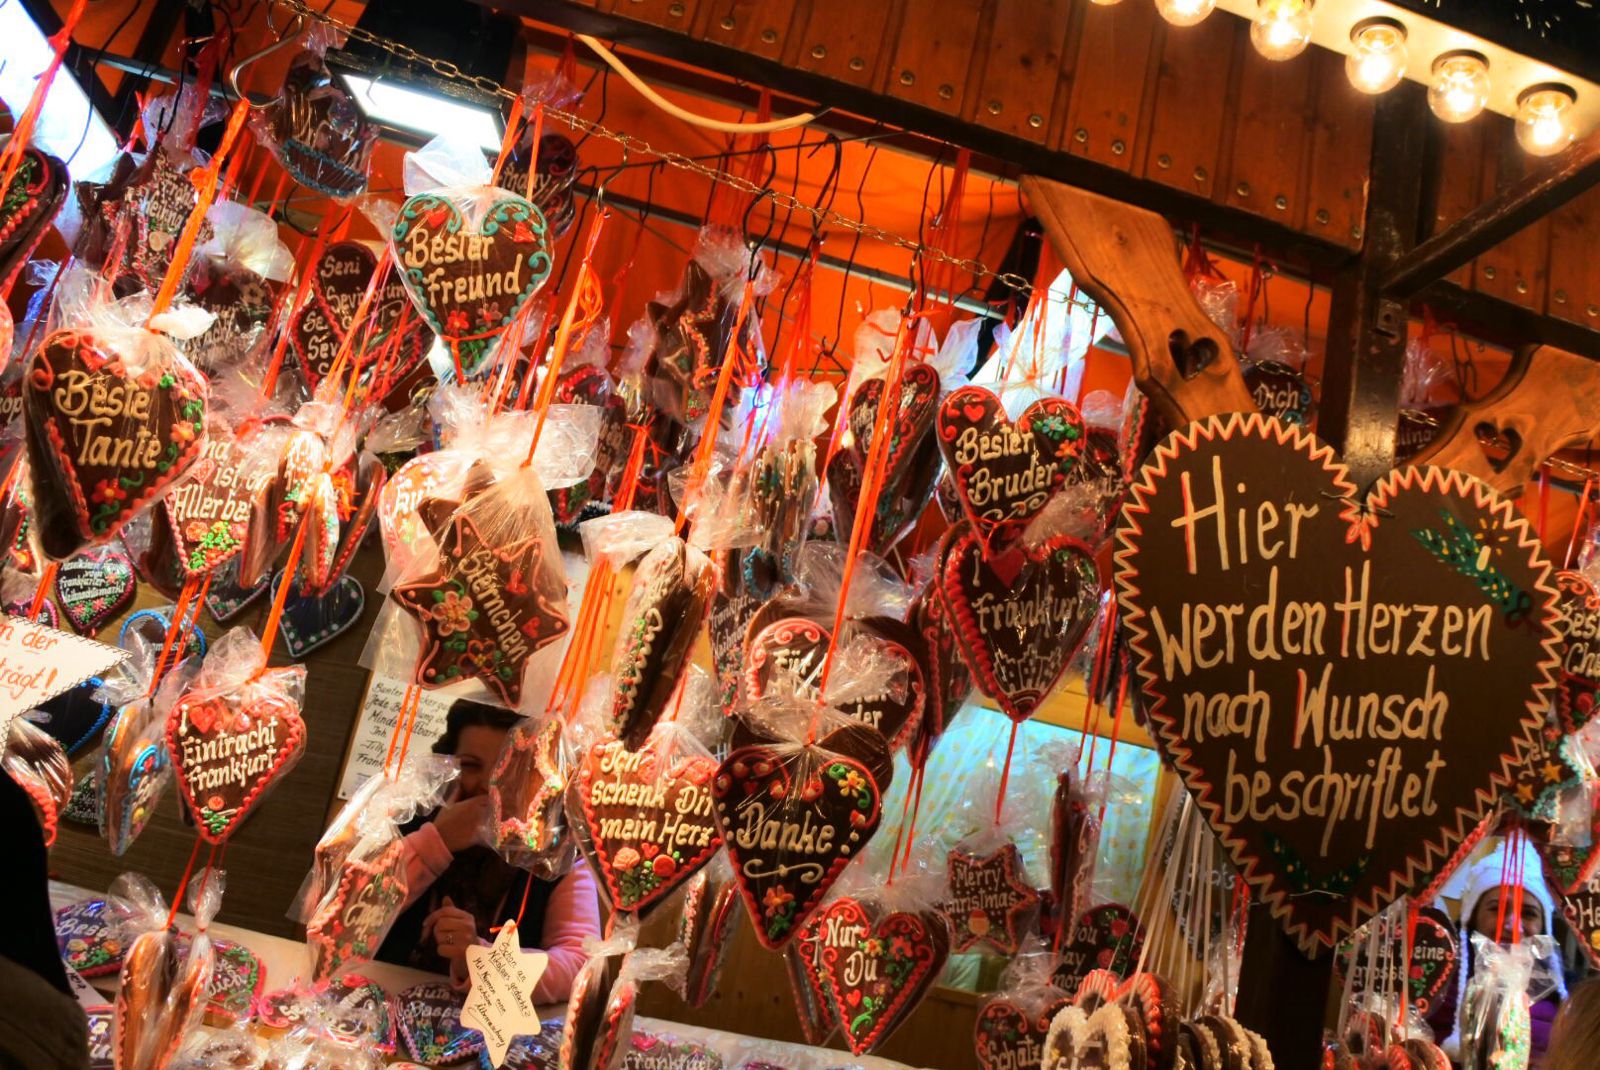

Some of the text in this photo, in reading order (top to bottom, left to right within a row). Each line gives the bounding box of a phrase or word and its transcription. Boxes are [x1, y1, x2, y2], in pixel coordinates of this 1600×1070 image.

[321, 254, 360, 278] Seni
[405, 228, 494, 269] Bester
[54, 370, 149, 419] Beste
[69, 417, 161, 468] Tante
[955, 426, 1035, 465] Bester
[967, 454, 1058, 506] Bruder
[1171, 454, 1319, 574] Hier
[459, 550, 528, 663] Sternchen
[971, 584, 1086, 638] Frankfurt
[1336, 559, 1493, 661] Herzen
[22, 627, 58, 651] der
[1182, 662, 1449, 763] nach Wunsch
[182, 716, 279, 768] Eintracht
[186, 746, 278, 799] Frankfurt
[1224, 745, 1447, 857] beschriftet
[600, 811, 714, 856] mein Herz
[736, 802, 835, 855] Danke
[956, 864, 1001, 891] Merry
[825, 915, 862, 949] Nur
[844, 951, 877, 987] Du
[1053, 972, 1082, 990] mor
